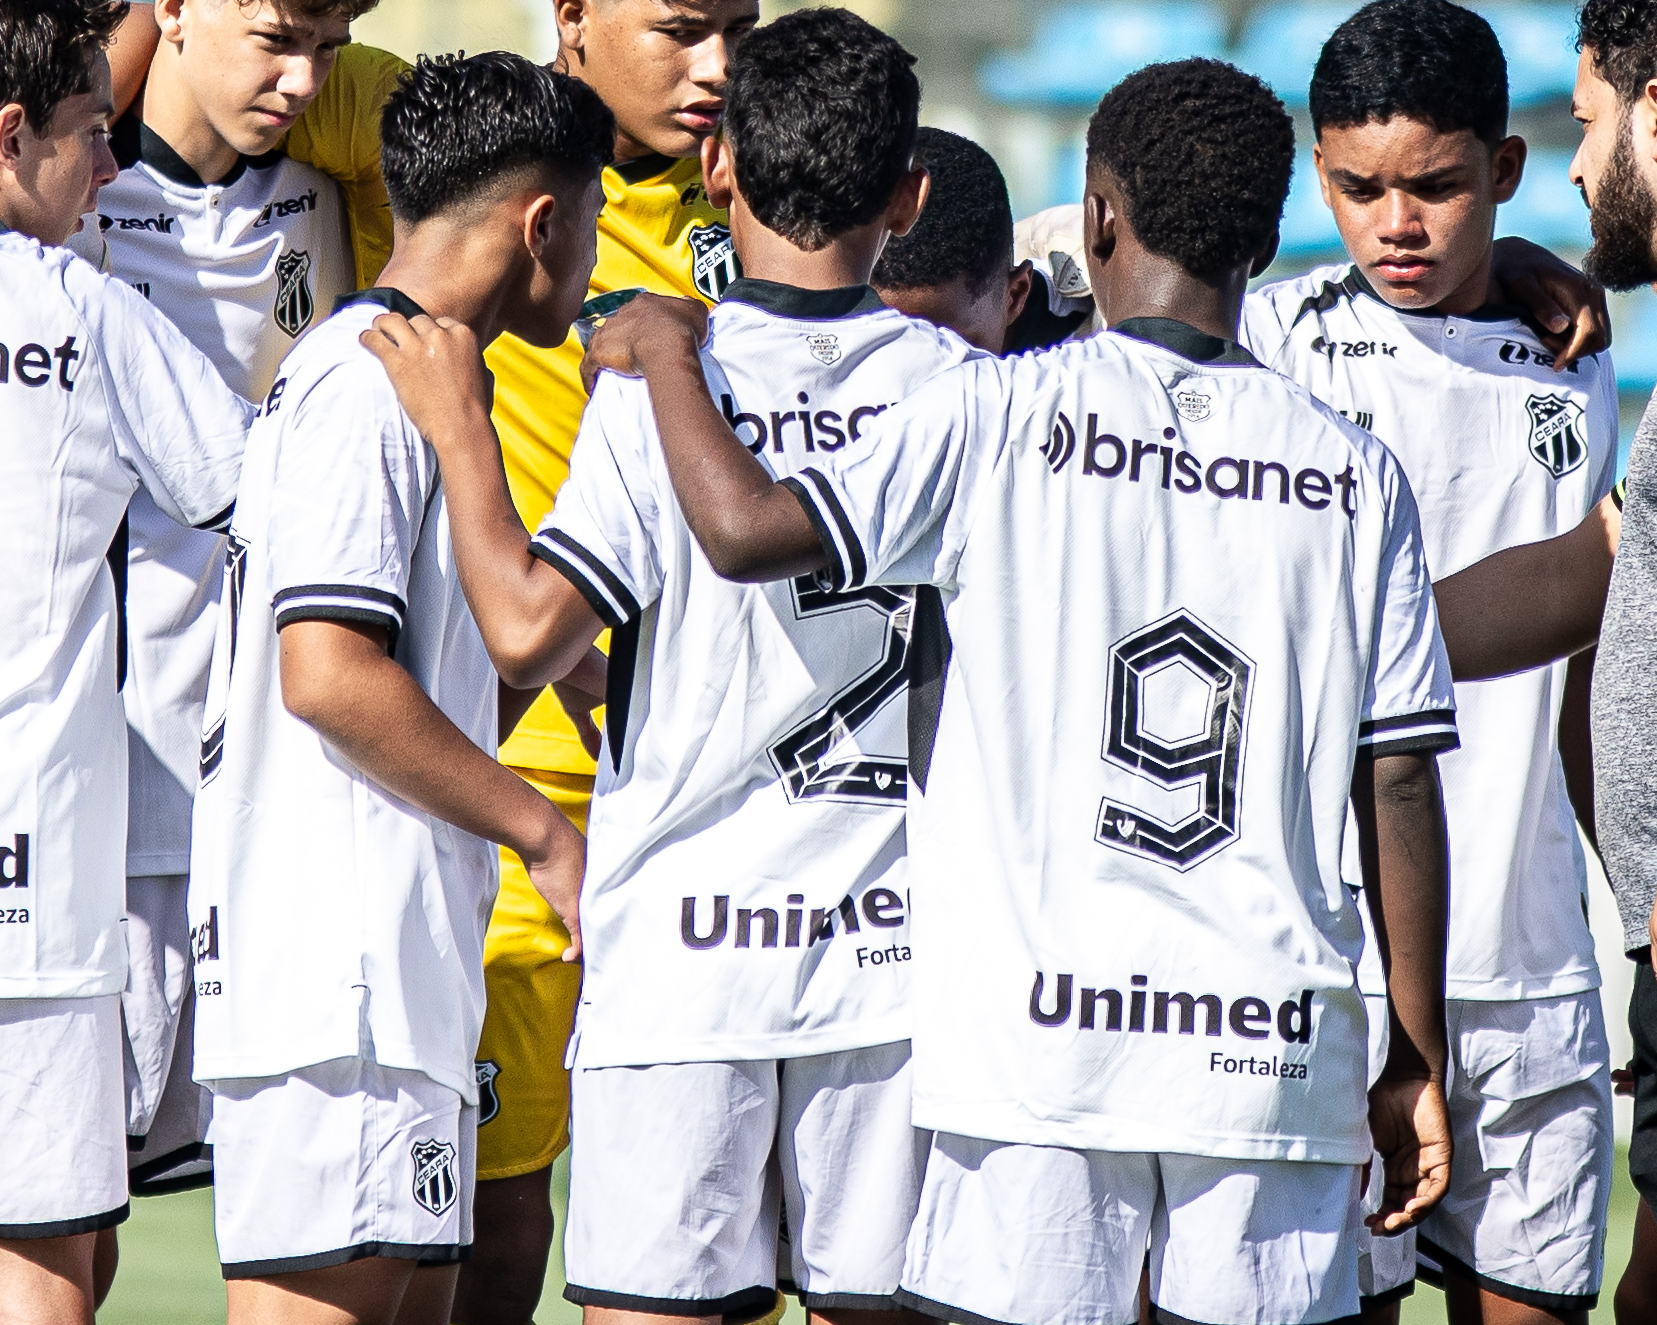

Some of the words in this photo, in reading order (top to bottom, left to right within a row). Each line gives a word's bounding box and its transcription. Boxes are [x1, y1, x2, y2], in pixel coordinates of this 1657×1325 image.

[113, 213, 175, 235] zenir
[272, 188, 318, 218] zenir
[1082, 412, 1358, 521] brisanet
[1094, 606, 1257, 874] 9
[679, 887, 912, 951] Unime
[855, 943, 913, 969] Forta
[1029, 969, 1316, 1045] Unimed
[1209, 1051, 1308, 1080] Fortaleza
